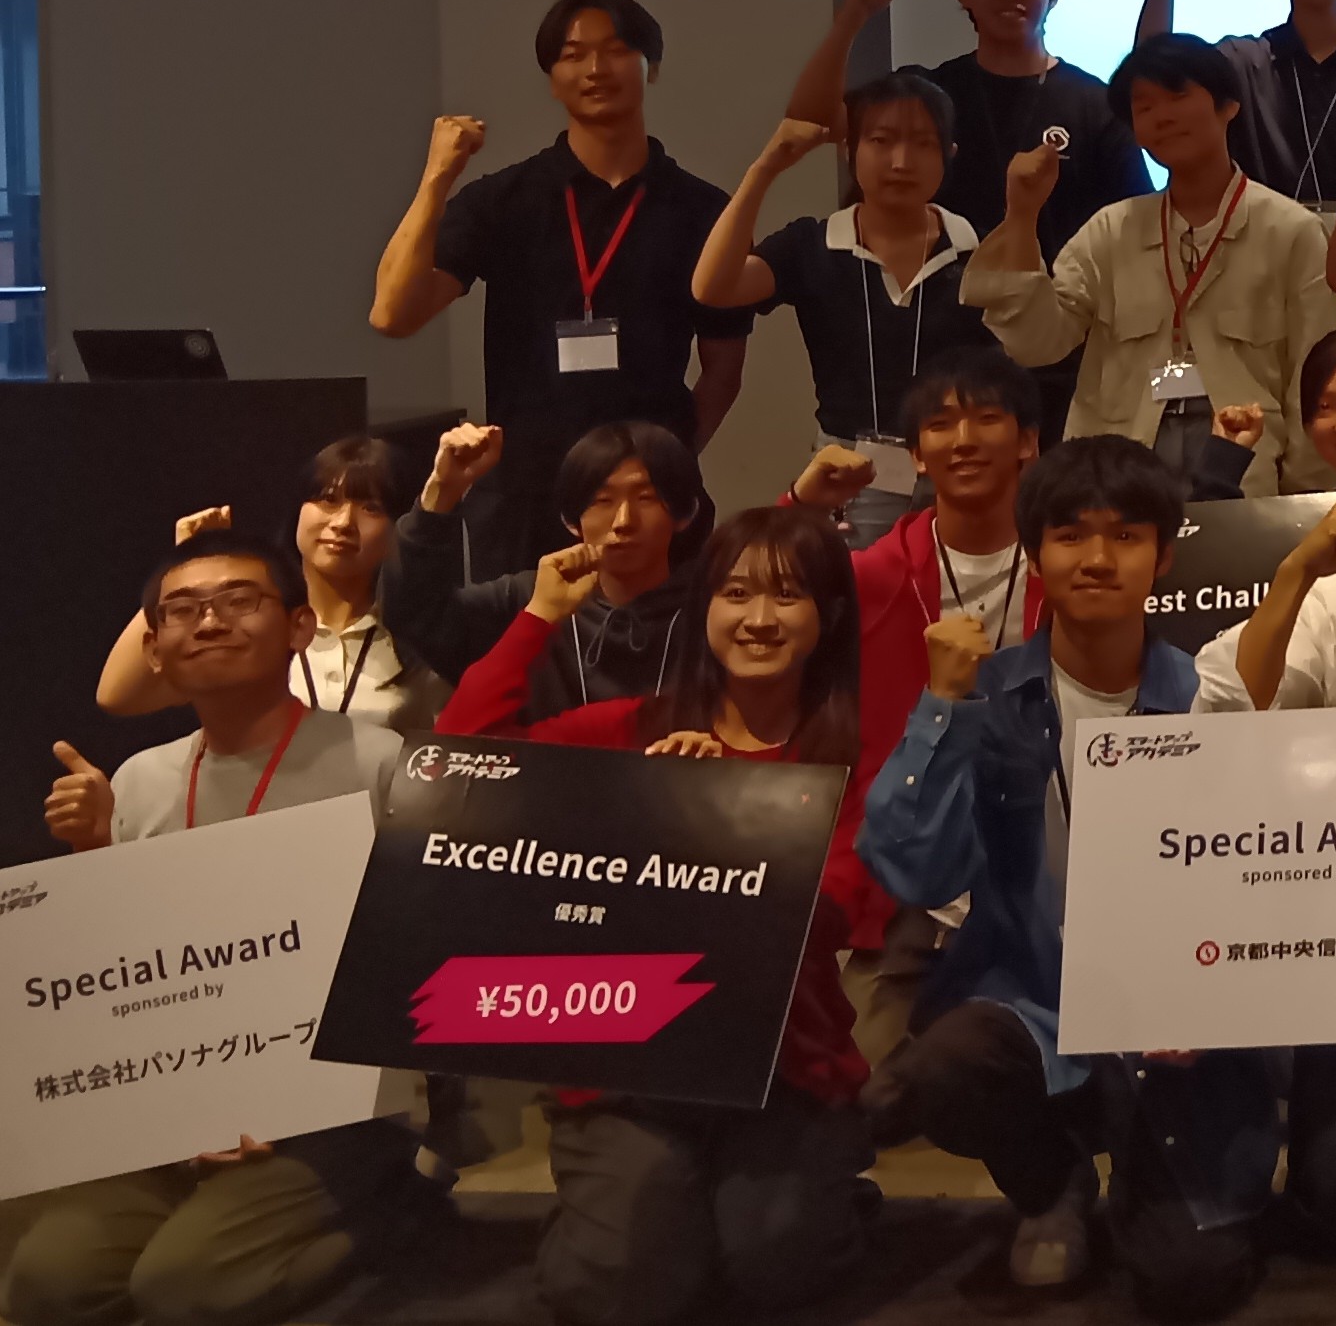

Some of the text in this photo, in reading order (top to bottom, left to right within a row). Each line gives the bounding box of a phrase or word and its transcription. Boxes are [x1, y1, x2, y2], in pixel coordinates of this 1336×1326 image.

[1143, 581, 1270, 614] est Chall
[422, 833, 768, 896] Excellence Award
[1158, 820, 1305, 866] Special
[1241, 865, 1333, 885] sponsored
[554, 902, 606, 925] 優秀賞
[25, 919, 301, 1011] Special Award
[111, 983, 225, 1018] sponsored by
[475, 980, 637, 1024] ¥50,000
[34, 1017, 317, 1103] 株式会社パソナグループ
